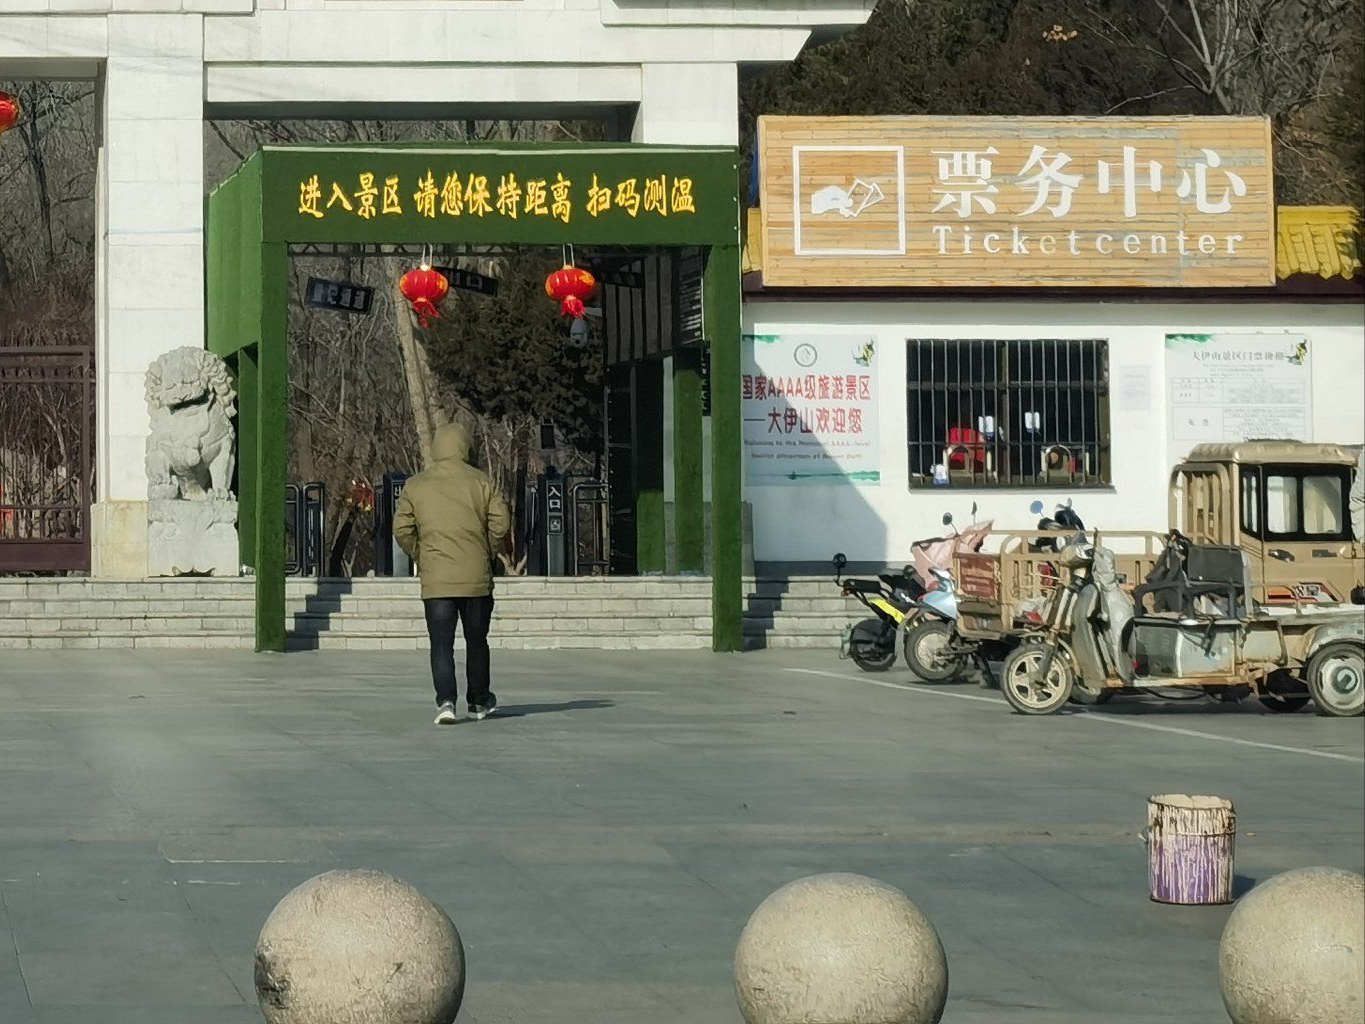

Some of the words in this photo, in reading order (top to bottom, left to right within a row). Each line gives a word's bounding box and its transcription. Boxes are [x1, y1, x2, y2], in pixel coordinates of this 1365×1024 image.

[299, 173, 403, 220] 进入景区
[414, 170, 572, 223] 请您保持距离
[586, 174, 696, 219] 扫码测温
[931, 145, 1247, 218] 票务中心
[742, 374, 871, 400] 国家AAAA级旅游景区
[548, 486, 561, 509] 入口
